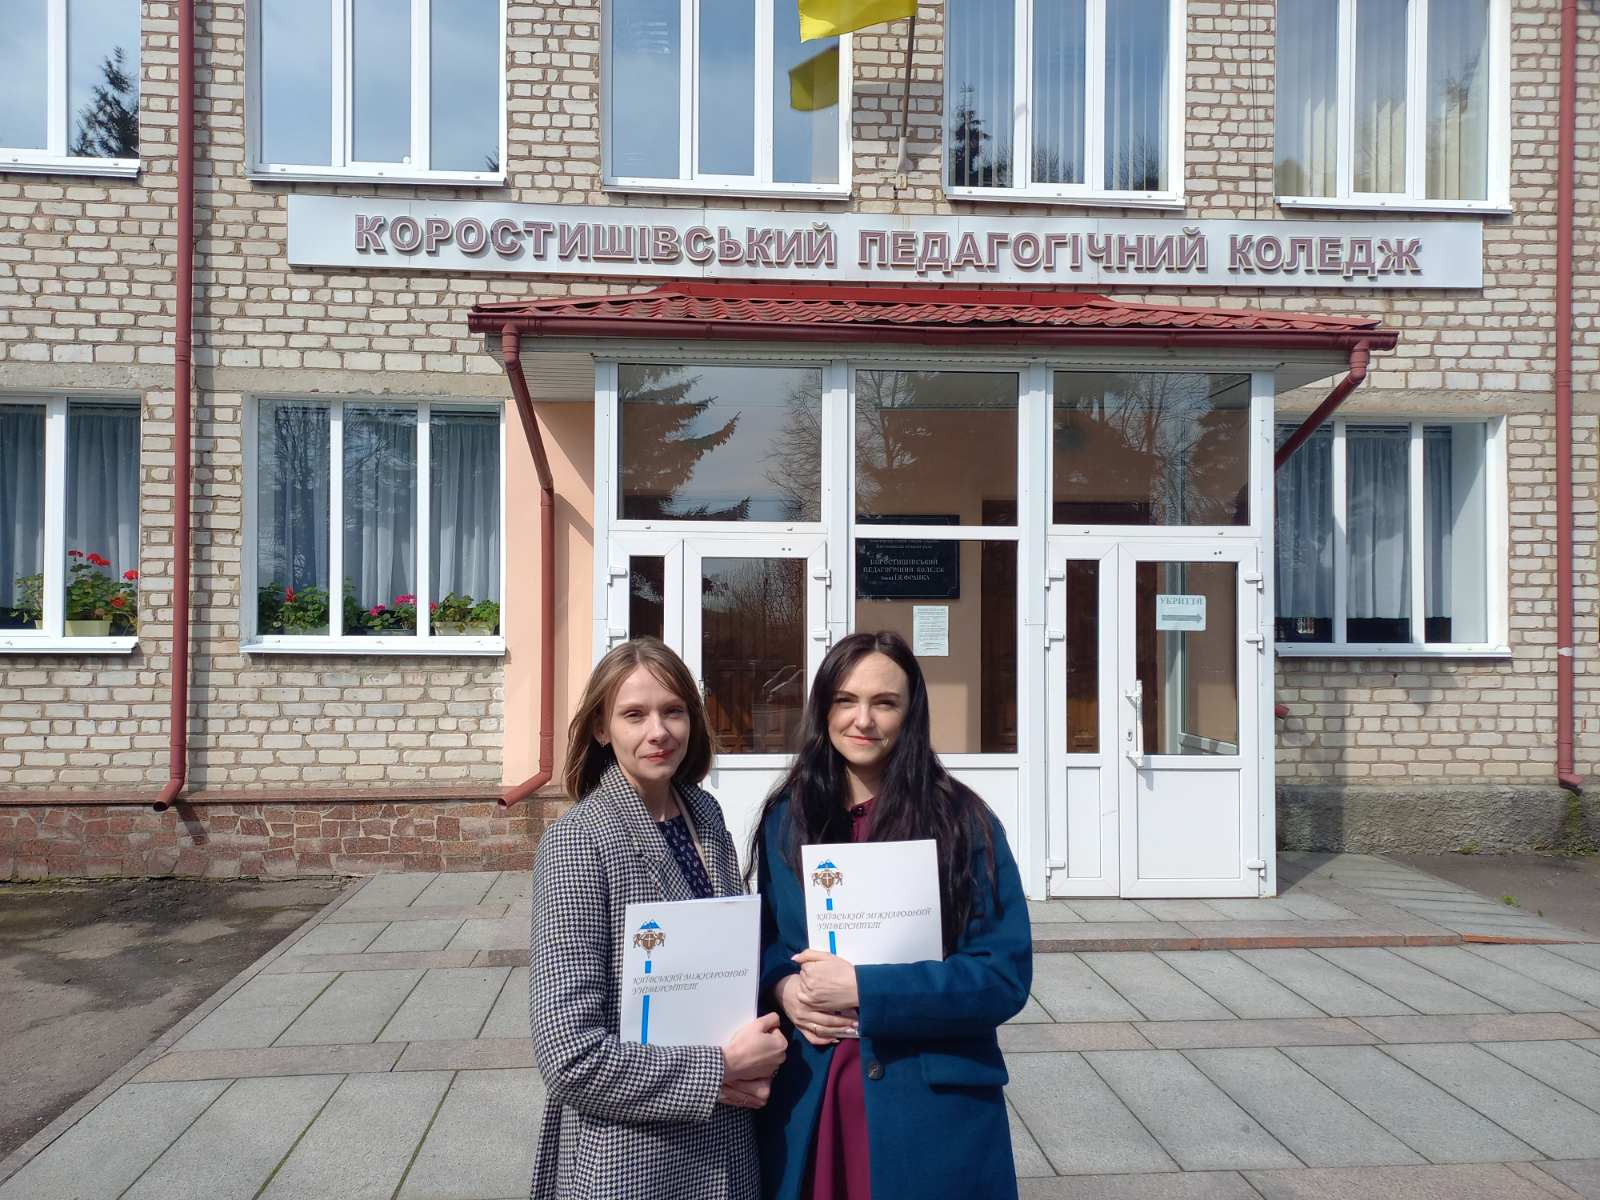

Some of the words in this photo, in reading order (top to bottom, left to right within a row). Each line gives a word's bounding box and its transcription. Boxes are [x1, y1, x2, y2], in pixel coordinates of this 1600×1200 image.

[355, 214, 837, 267] КОРОСТИШІВСЬКИЙ
[858, 226, 1209, 273] ПЕДАГОГІЧНИЙ
[1228, 233, 1423, 279] КОЛЕДЖ
